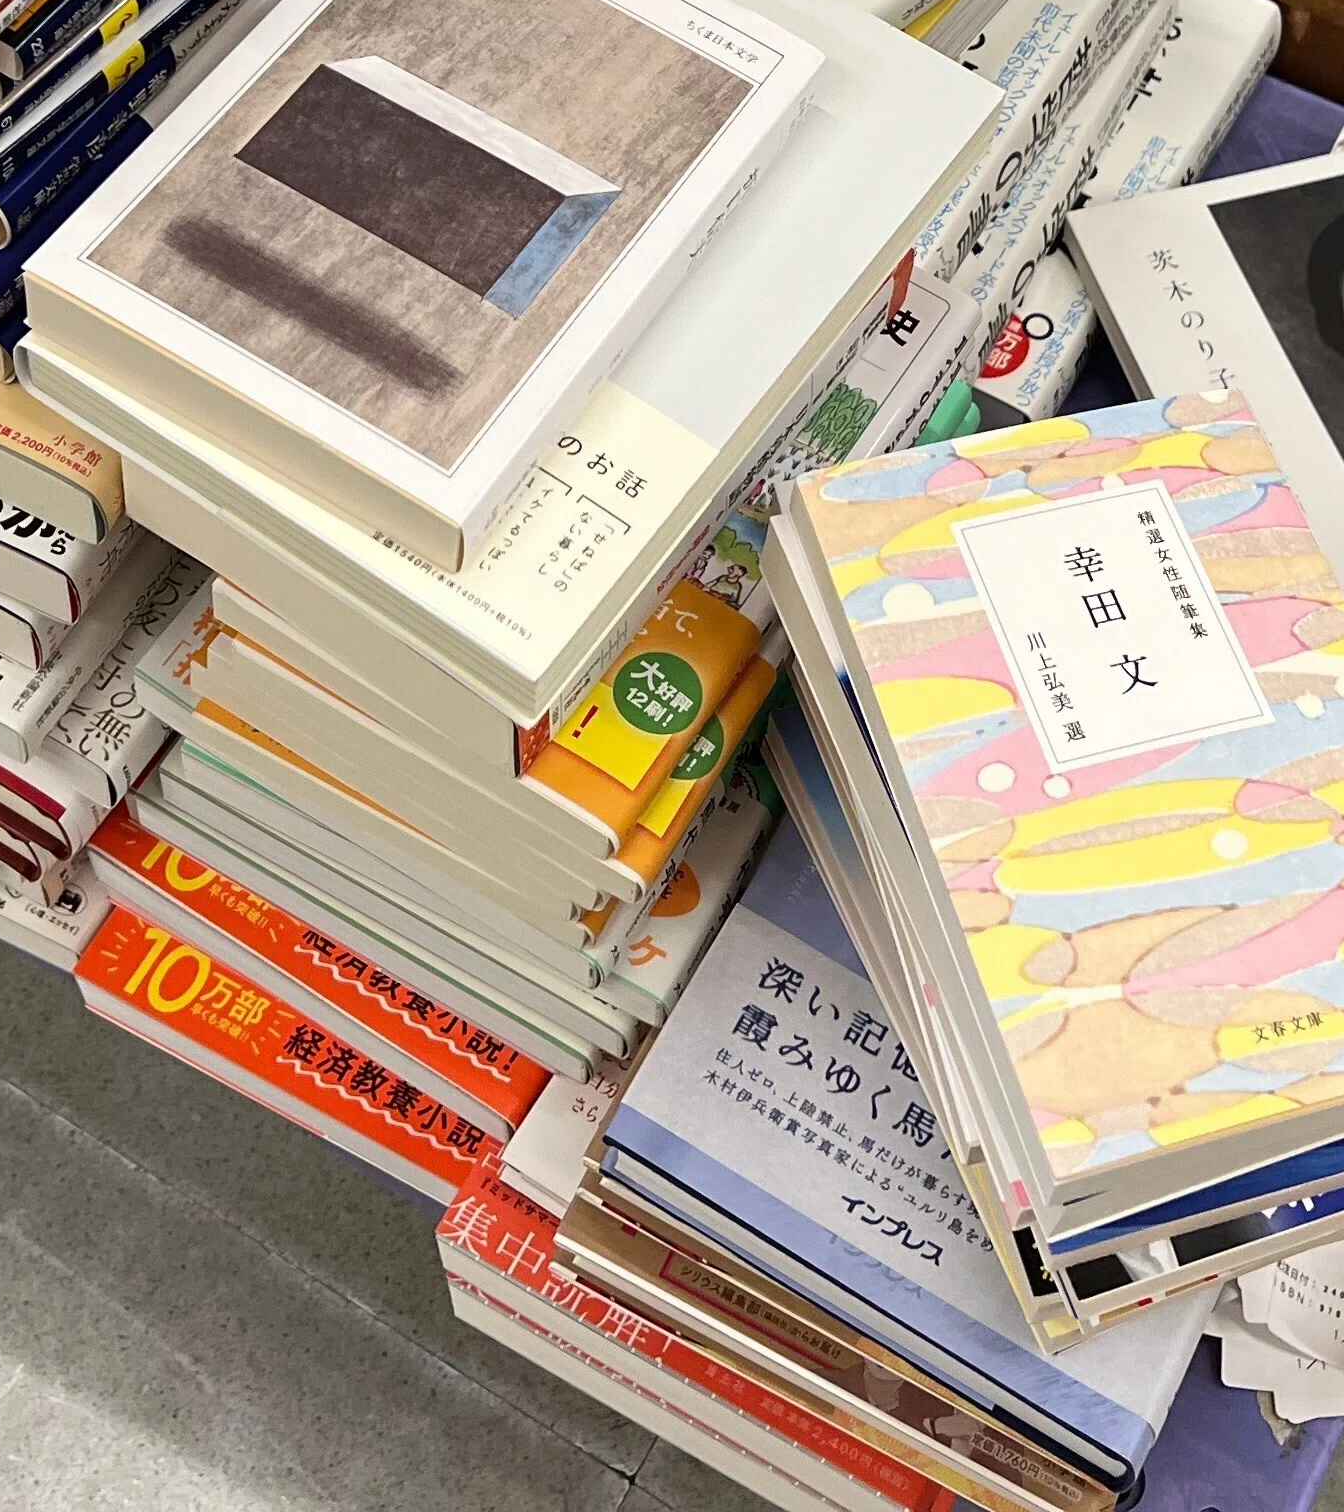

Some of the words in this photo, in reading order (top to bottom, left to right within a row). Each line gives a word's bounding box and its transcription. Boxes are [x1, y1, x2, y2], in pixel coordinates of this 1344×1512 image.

[685, 18, 761, 67] ちくま日本文学
[51, 432, 103, 467] 小学館
[1137, 511, 1209, 640] 精選女性随筆集
[625, 686, 676, 728] 12刷!
[630, 658, 692, 715] 大好評
[125, 928, 265, 1026] 10万部
[1253, 1012, 1325, 1045] 文春文庫
[841, 1195, 944, 1267] インプレス
